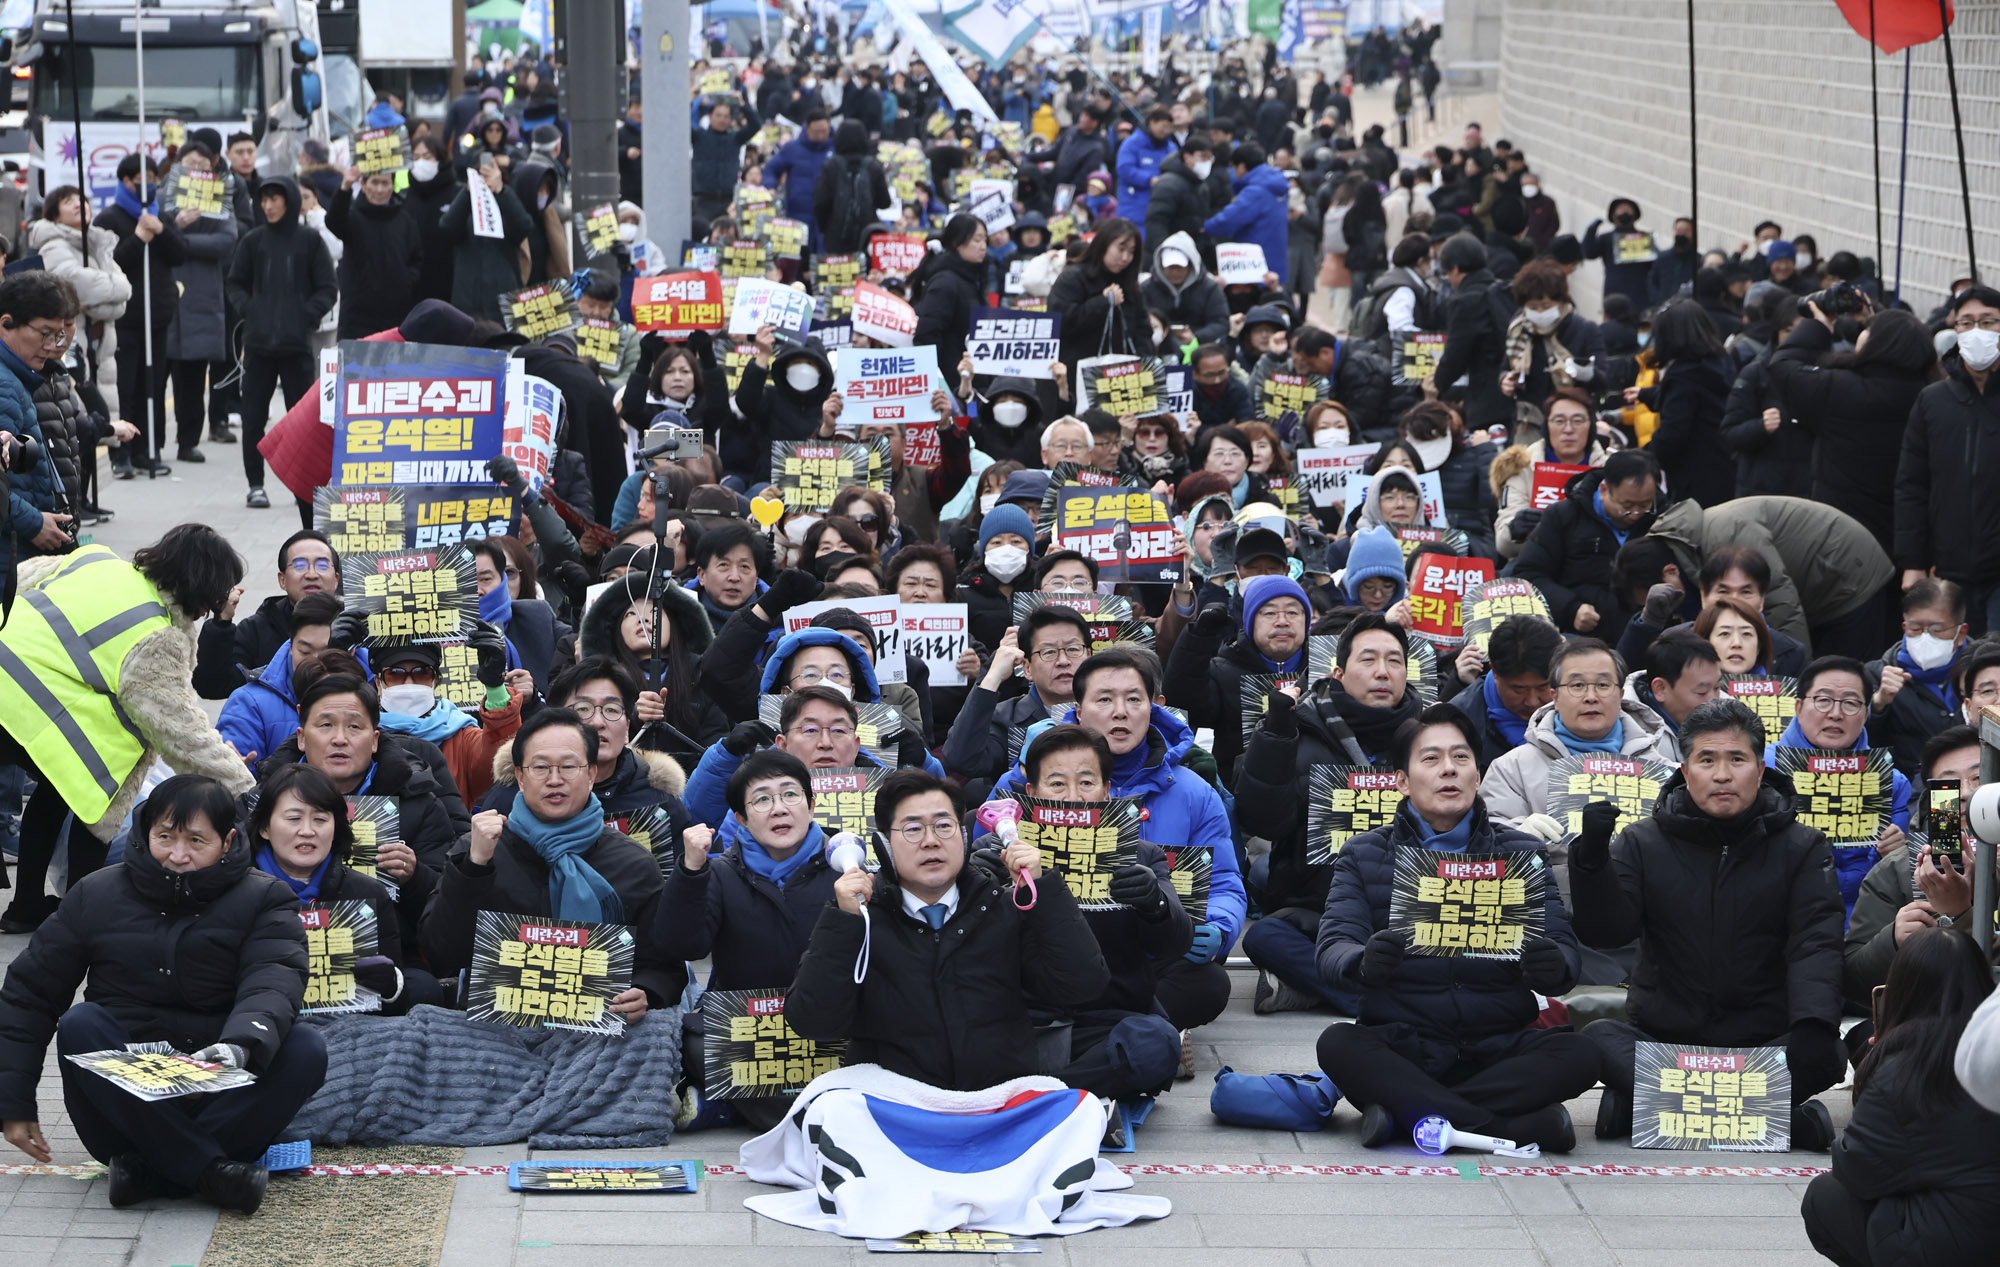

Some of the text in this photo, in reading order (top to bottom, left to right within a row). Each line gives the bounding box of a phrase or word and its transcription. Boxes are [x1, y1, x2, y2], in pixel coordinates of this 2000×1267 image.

[650, 280, 706, 302] 윤석열
[635, 303, 721, 326] 즉각 파면!
[974, 318, 1053, 340] 김건희를
[973, 341, 1057, 361] 수사하라!
[860, 356, 916, 377] 헌재는
[346, 380, 493, 414] 내란수괴
[847, 375, 929, 399] 즉각파면!
[875, 407, 903, 418] 진보당
[345, 417, 474, 454] 윤석열!
[1081, 472, 1114, 487] 내란수괴
[345, 491, 381, 503] 내란수괴
[1064, 492, 1170, 528] 윤석열을
[383, 555, 429, 571] 내란수괴
[364, 569, 458, 597] 윤석열을
[1159, 571, 1179, 580] 민주당
[1423, 565, 1483, 595] 윤석열
[367, 609, 461, 637] 파면하라
[1733, 682, 1774, 694] 내란수괴
[1589, 760, 1635, 773] 내란수괴
[1814, 758, 1859, 771] 내란수괴
[811, 775, 858, 791] 내란수괴
[1568, 773, 1661, 800] 윤석열을
[1792, 771, 1880, 796] 윤석열을
[1039, 809, 1091, 825] 내란수괴
[1445, 862, 1497, 877] 내란수괴
[1417, 876, 1525, 905] 윤석열을
[526, 927, 579, 944] 내란수괴
[1413, 921, 1526, 950] 파면하라
[498, 940, 609, 977] 윤석열을
[493, 986, 605, 1022] 파면하라
[1684, 1055, 1736, 1069] 내란수괴
[1659, 1068, 1767, 1096] 윤석열을
[1658, 1112, 1768, 1140] 파면하라
